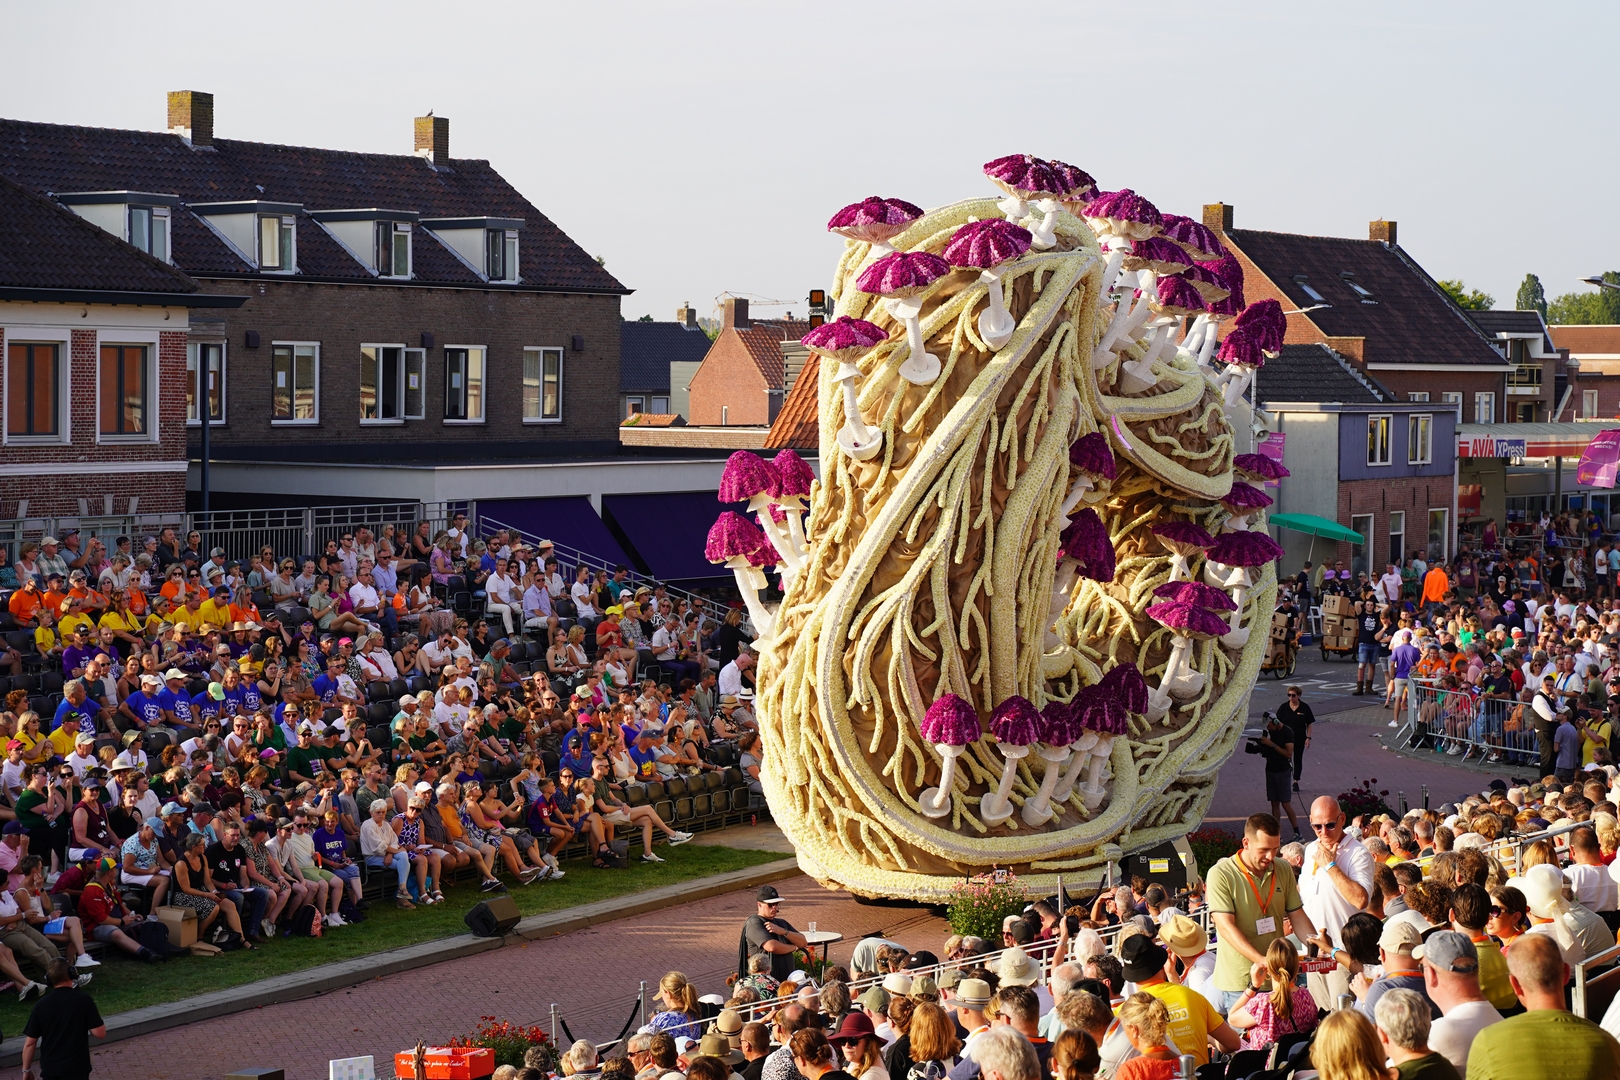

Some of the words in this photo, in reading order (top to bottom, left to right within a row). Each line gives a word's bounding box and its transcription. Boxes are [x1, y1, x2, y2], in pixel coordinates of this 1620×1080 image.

[1472, 434, 1495, 457] AVIA
[1497, 441, 1523, 457] XPress
[1305, 960, 1336, 972] Jupiler
